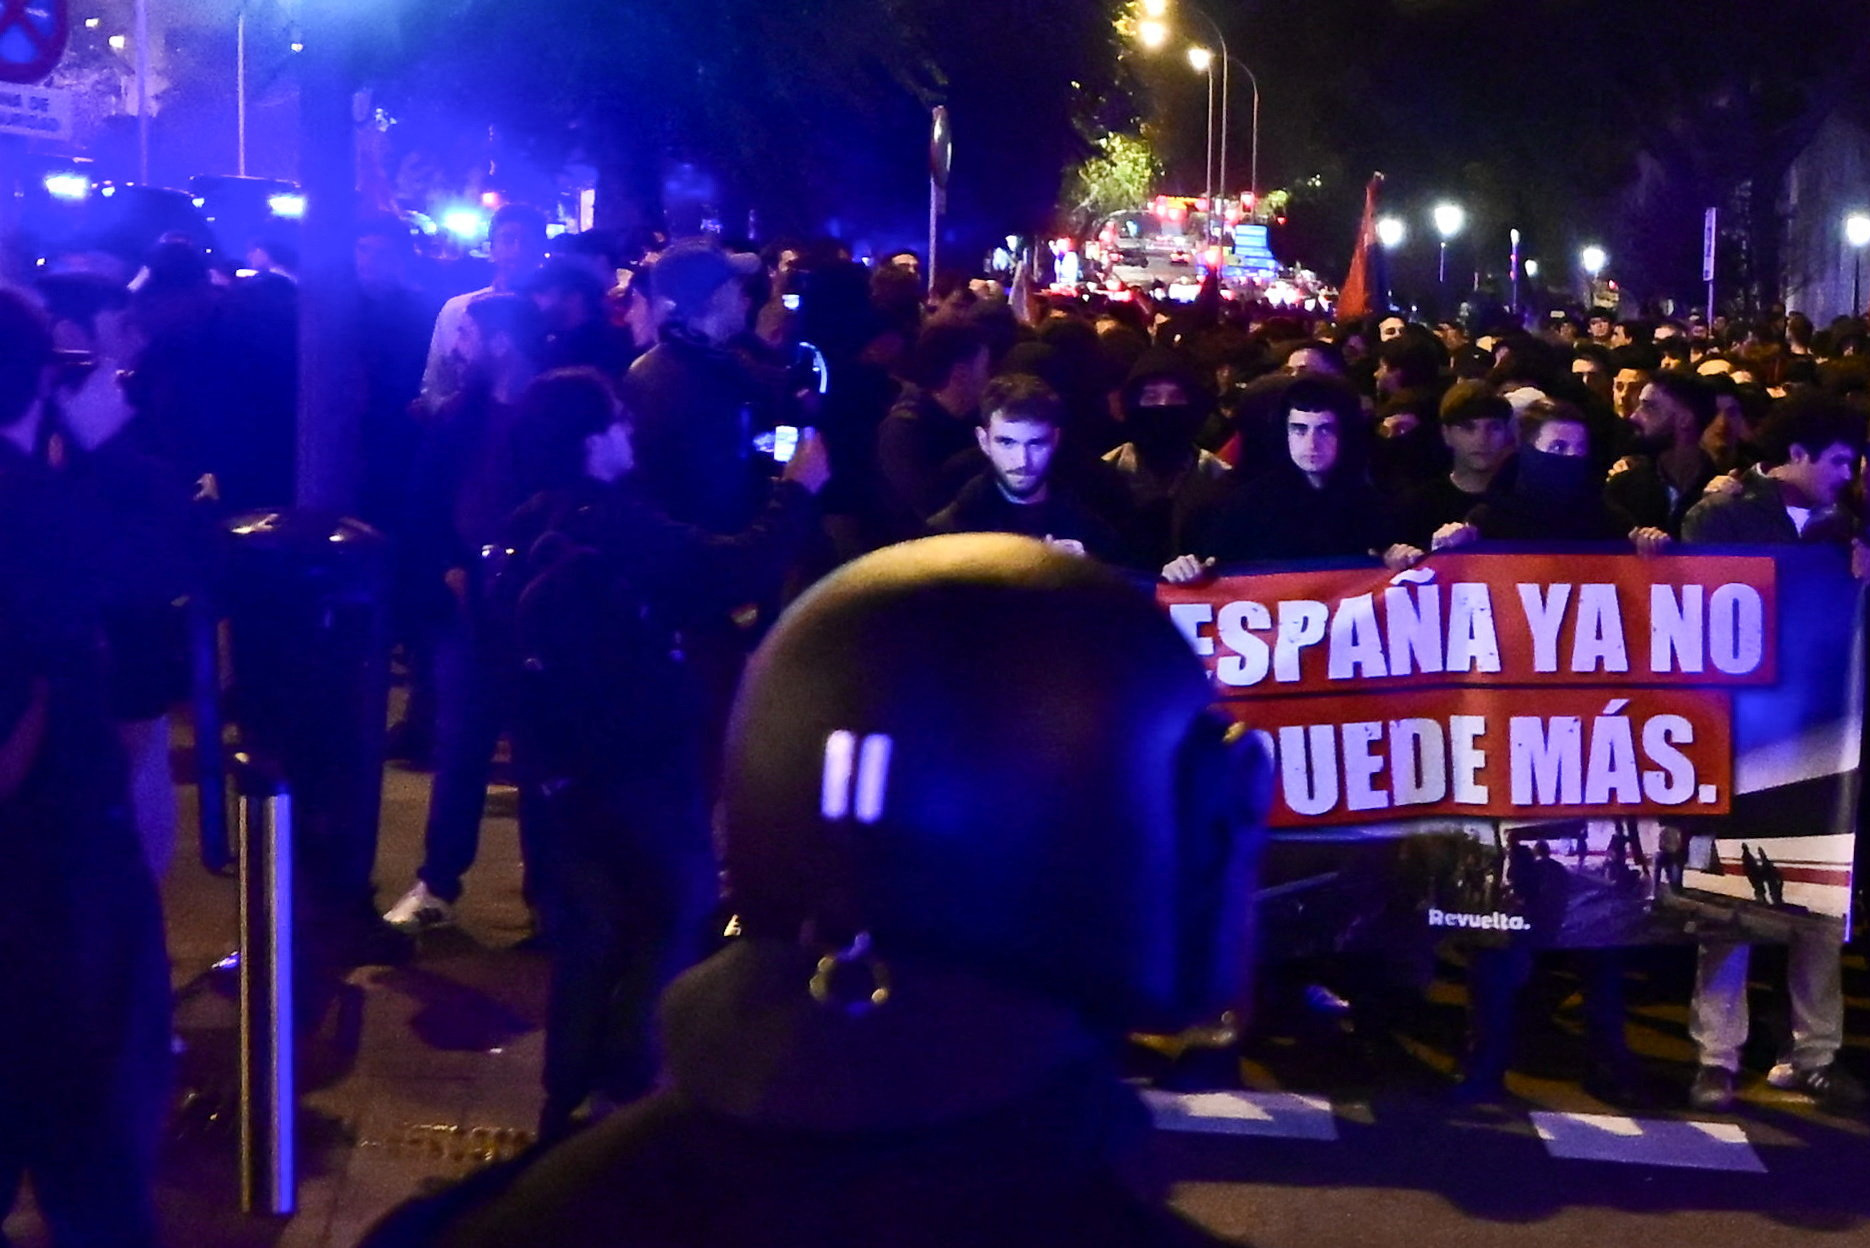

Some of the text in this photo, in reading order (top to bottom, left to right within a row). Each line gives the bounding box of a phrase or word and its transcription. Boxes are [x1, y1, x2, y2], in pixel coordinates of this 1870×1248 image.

[1516, 582, 1628, 673] YA
[1649, 583, 1763, 675] NO
[1247, 699, 1718, 815] UEDE MÁS.
